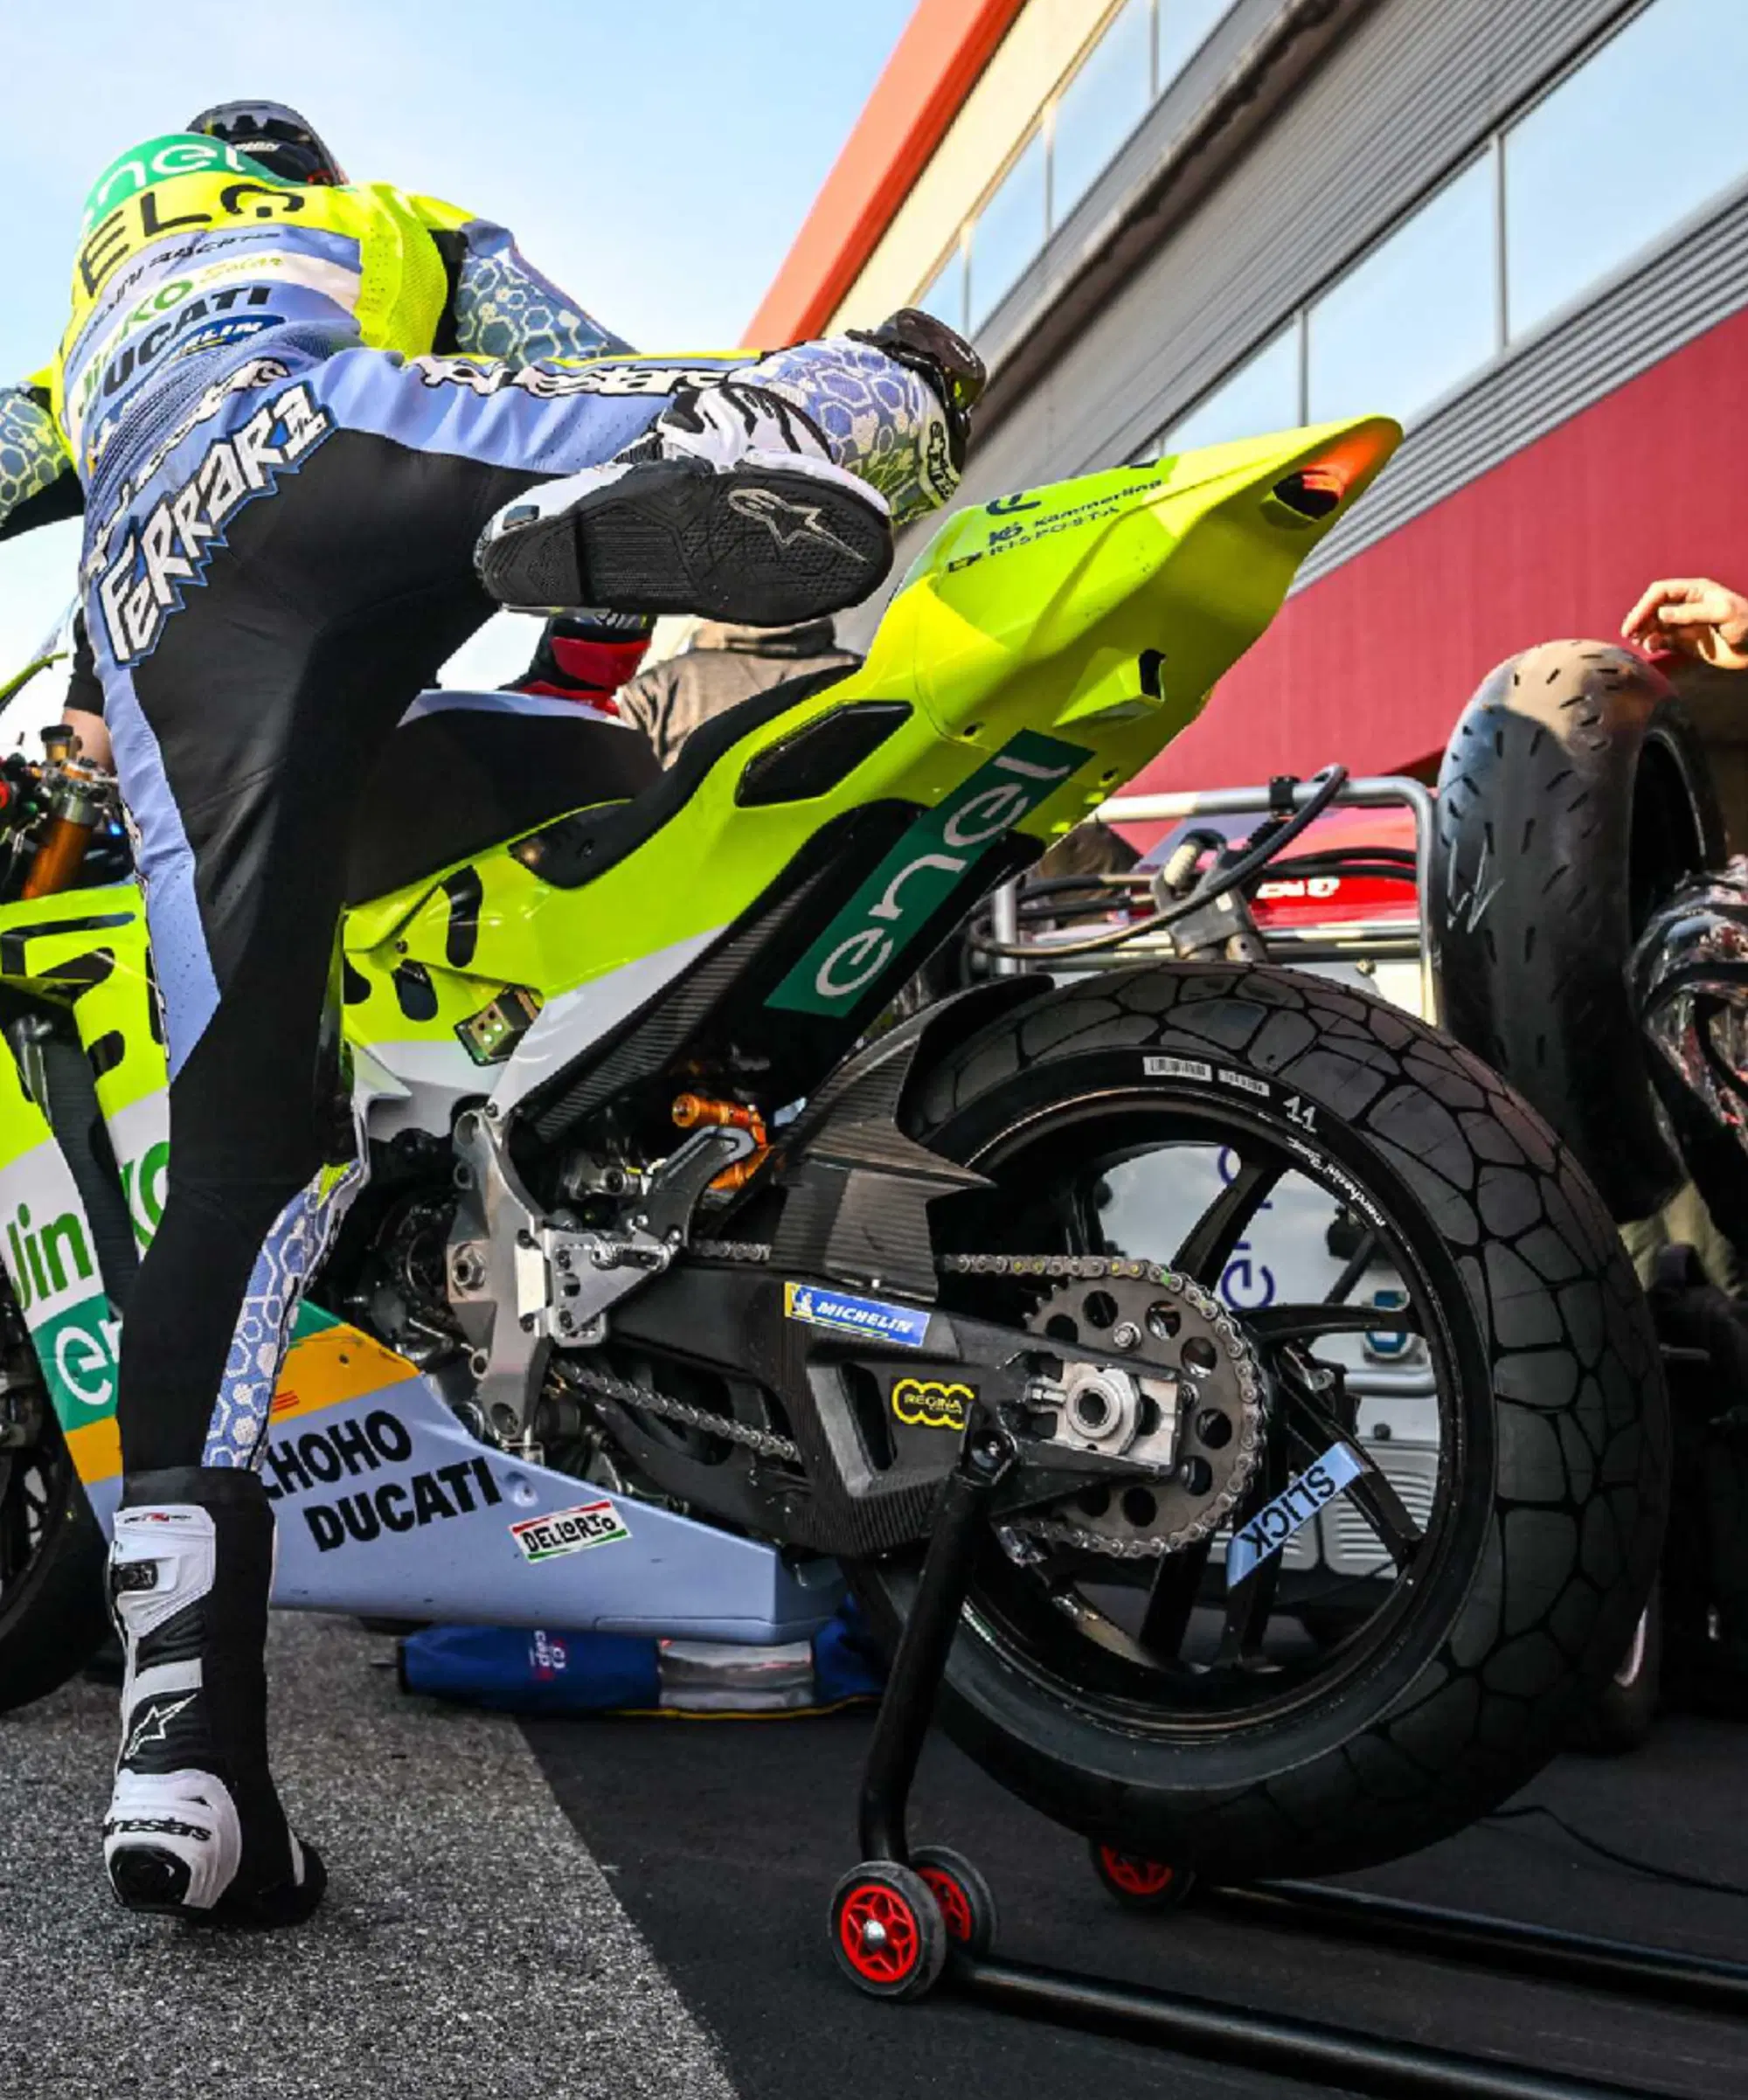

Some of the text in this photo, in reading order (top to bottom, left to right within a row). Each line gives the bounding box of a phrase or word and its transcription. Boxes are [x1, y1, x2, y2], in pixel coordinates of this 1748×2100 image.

[93, 286, 271, 411] UCATI
[815, 756, 1071, 998] enel
[816, 1301, 915, 1334] MICHELIN
[303, 1456, 503, 1552] DUCATI
[1240, 1466, 1336, 1558] SLICK
